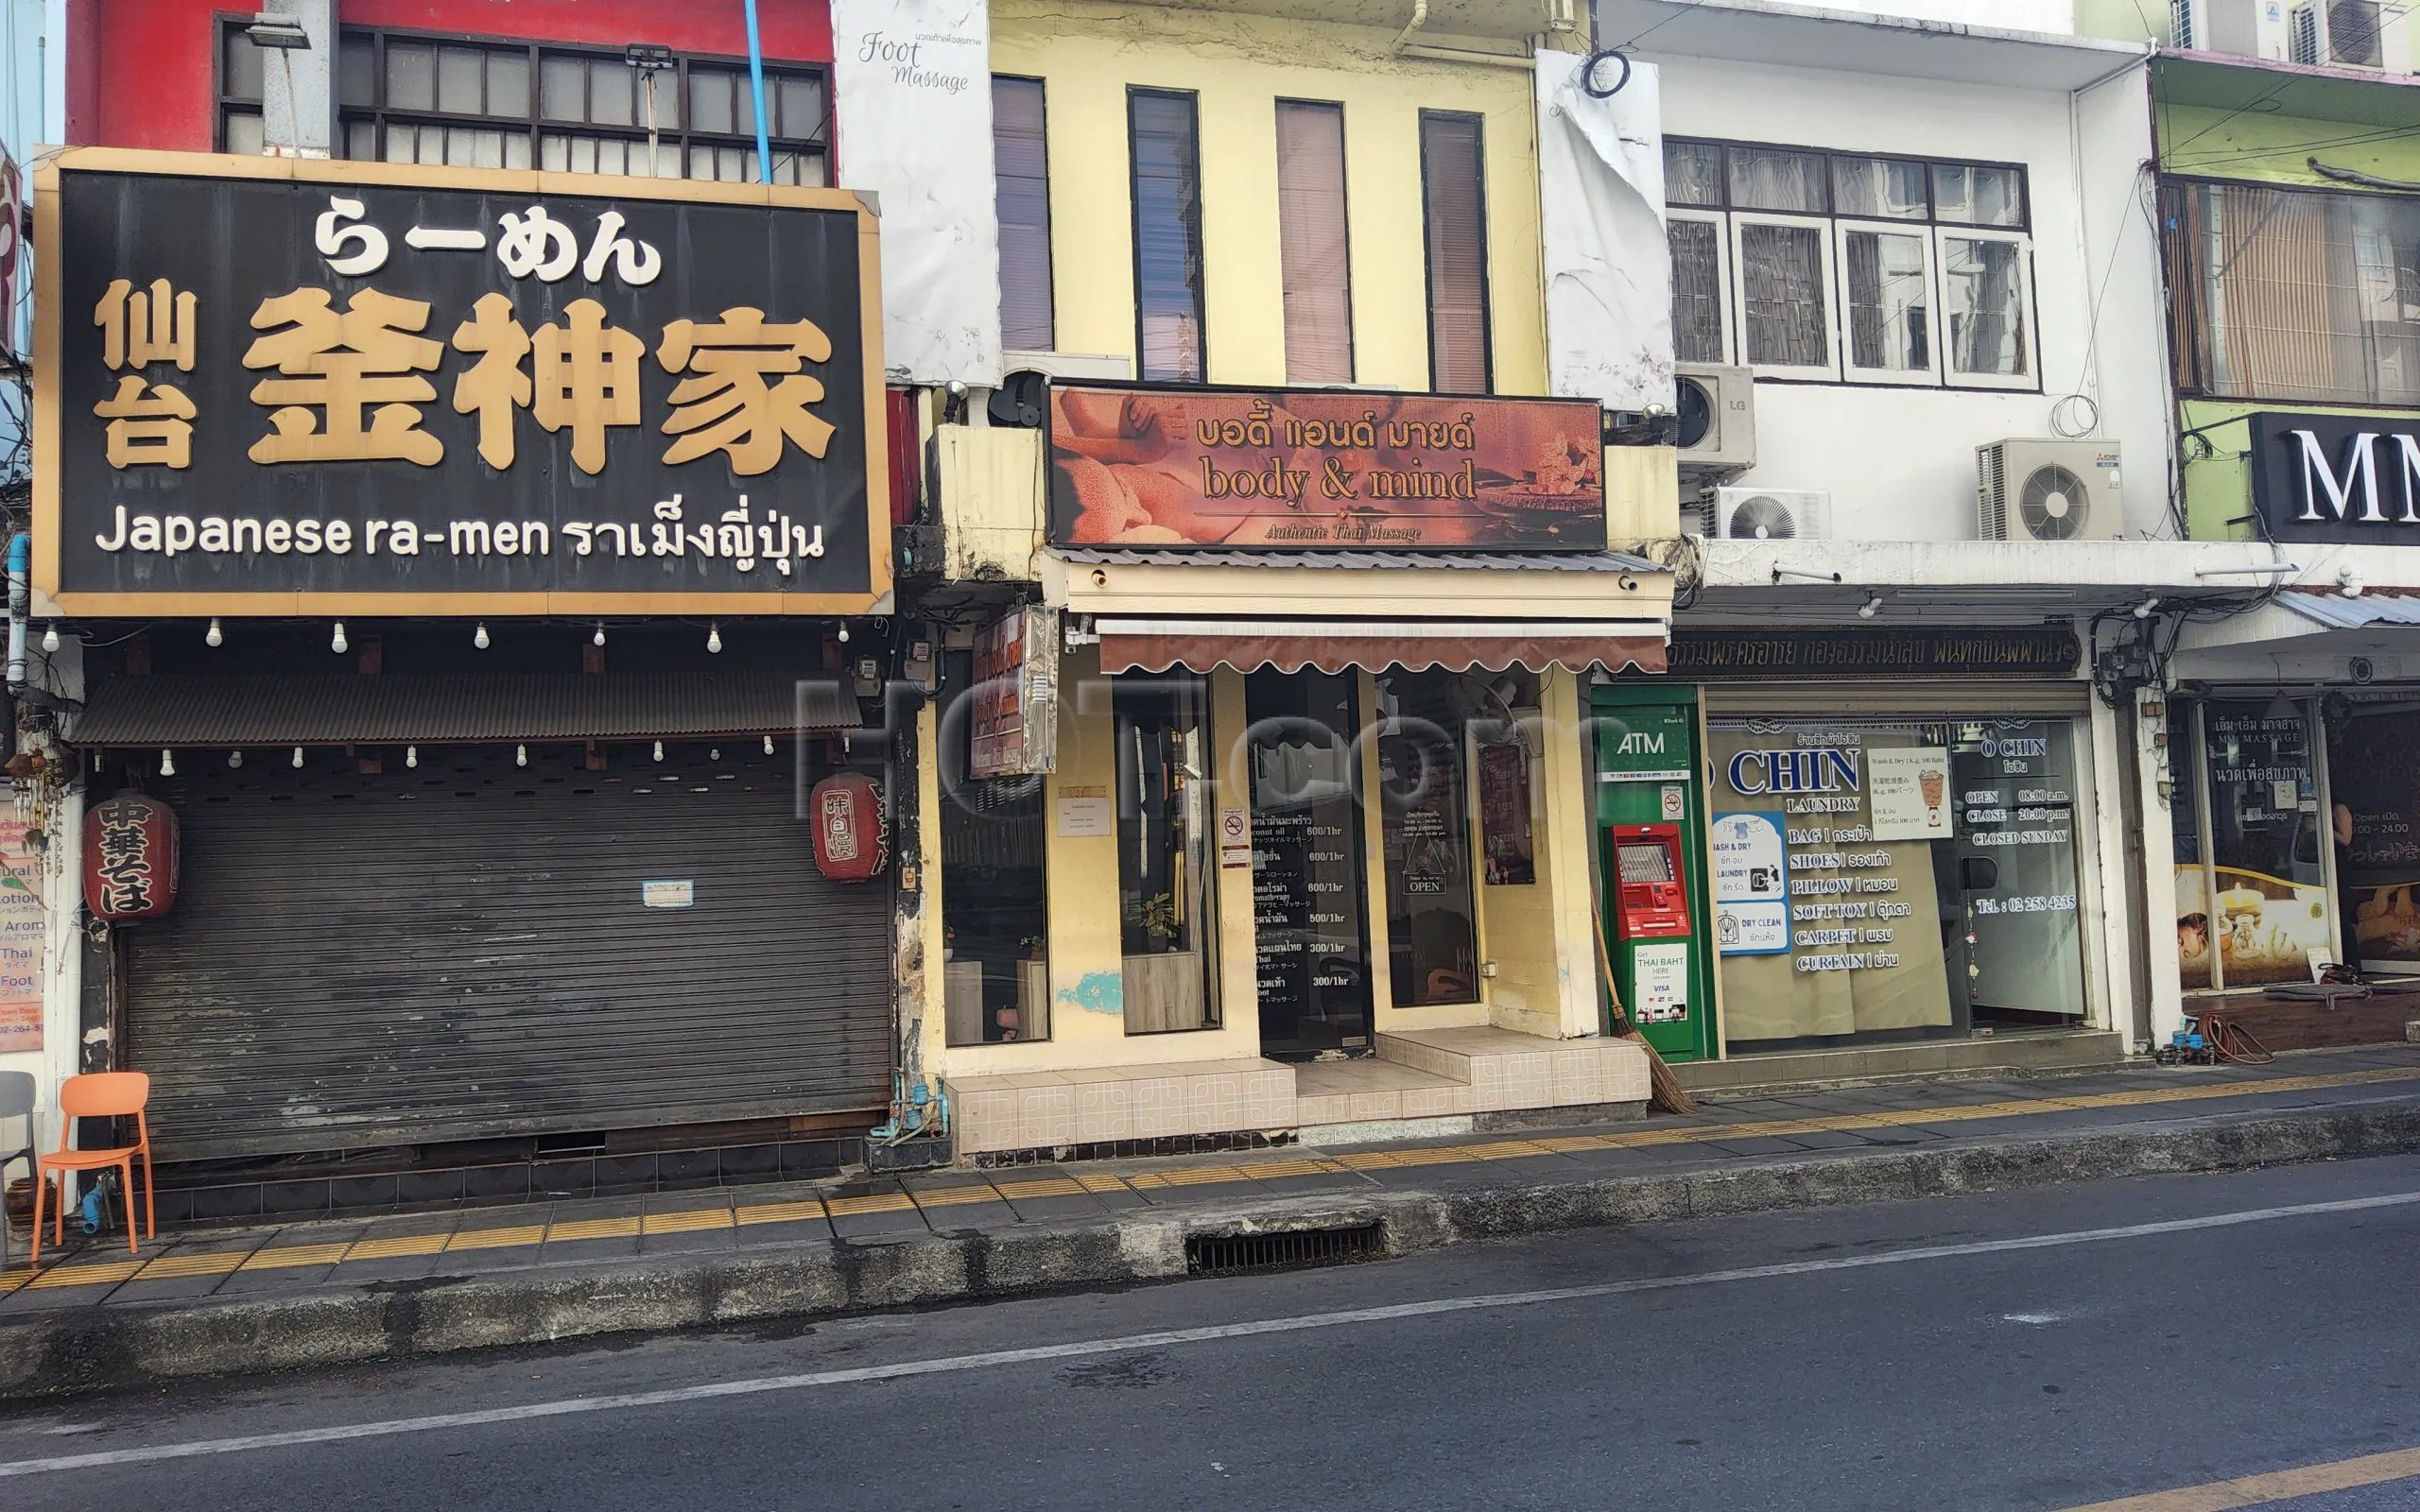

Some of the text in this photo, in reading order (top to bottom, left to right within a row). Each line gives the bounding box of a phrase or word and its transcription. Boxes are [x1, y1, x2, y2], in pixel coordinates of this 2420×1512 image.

[858, 31, 922, 68] Foot
[891, 65, 968, 95] Massage
[315, 196, 663, 285] らーめん
[93, 278, 197, 471] 仙台
[241, 286, 836, 476] 釜神家
[1730, 401, 1746, 410] LG
[1197, 399, 1477, 450] บอดี้ แอนด์ มายด์
[1199, 455, 1478, 507] body & mind
[95, 493, 825, 576] Japanese ra-men ราเม็งญี่ปุ่น
[1265, 524, 1422, 541] Authentic Thai Massage
[1616, 731, 1665, 755] ATM
[2243, 733, 2299, 743] MASSAGE
[1981, 739, 2046, 757] O CHIN
[1728, 748, 1860, 795] CHIN
[2216, 759, 2308, 785] นวดเพื่อสุขภาพ
[1965, 790, 2068, 803] OPEN 08:00 a.m.
[1787, 797, 1860, 813] LAUNDRY
[1967, 808, 2069, 822] CLOSE 20:00 p.m.
[825, 796, 854, 857] 味自慢
[1275, 827, 1285, 835] oil
[1306, 826, 1342, 835] 600/1hr
[1789, 828, 1822, 844] BAG
[1973, 830, 2067, 846] CLOSED SUNDAY
[98, 800, 154, 914] 中華そば
[1308, 851, 1344, 861] 600/1hr
[1790, 853, 1840, 868] SHOES
[1849, 850, 1891, 867] รองเท้า
[1717, 869, 1748, 878] LAUNDRY
[1307, 883, 1343, 892] 600/1hr
[1409, 883, 1440, 892] OPEN
[1791, 878, 1853, 894] PILLOW
[1863, 878, 1898, 891] หมอน
[1793, 904, 1832, 920] SOFT
[1835, 902, 1866, 918] TOY
[1977, 900, 1999, 914] Tel.
[2008, 899, 2024, 912] 02
[2024, 897, 2047, 911] 258
[2048, 896, 2076, 909] 4235
[1309, 914, 1344, 922] 500/1hr
[1757, 919, 1781, 927] CLEAN
[1795, 929, 1856, 945] CARPET
[1867, 929, 1893, 942] พรม
[2, 947, 32, 959] Thai
[1309, 943, 1345, 953] 300/1hr
[1637, 957, 1684, 967] THAI BAHT
[1797, 954, 1864, 971] CURTAIN
[1, 975, 33, 986] Foot
[1313, 976, 1349, 986] 300/1hr
